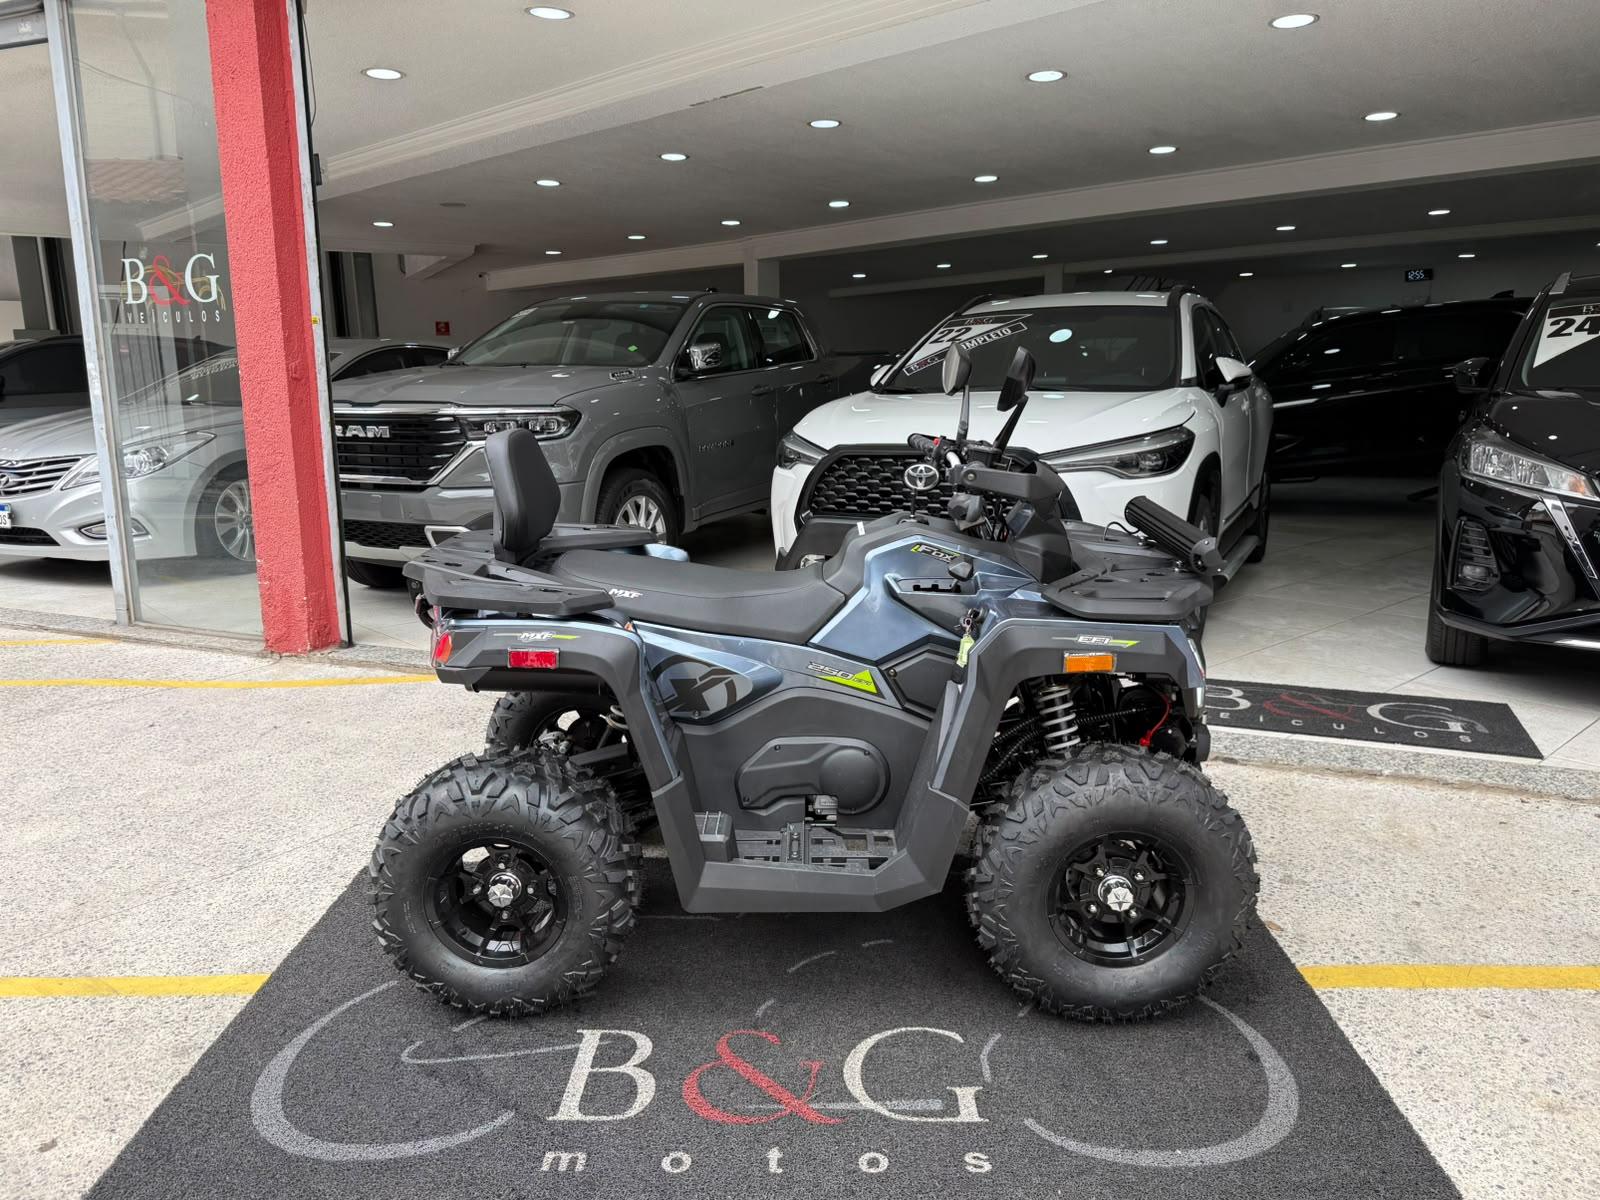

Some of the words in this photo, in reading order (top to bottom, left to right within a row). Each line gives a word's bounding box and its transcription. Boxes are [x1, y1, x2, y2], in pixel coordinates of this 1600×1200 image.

[120, 252, 220, 305] B&G
[928, 327, 973, 345] 22
[960, 327, 1012, 350] MPLETO
[1546, 316, 1600, 339] 24
[1202, 711, 1473, 743] EICULOS
[546, 1027, 990, 1126] B&G
[539, 1146, 993, 1174] motos
